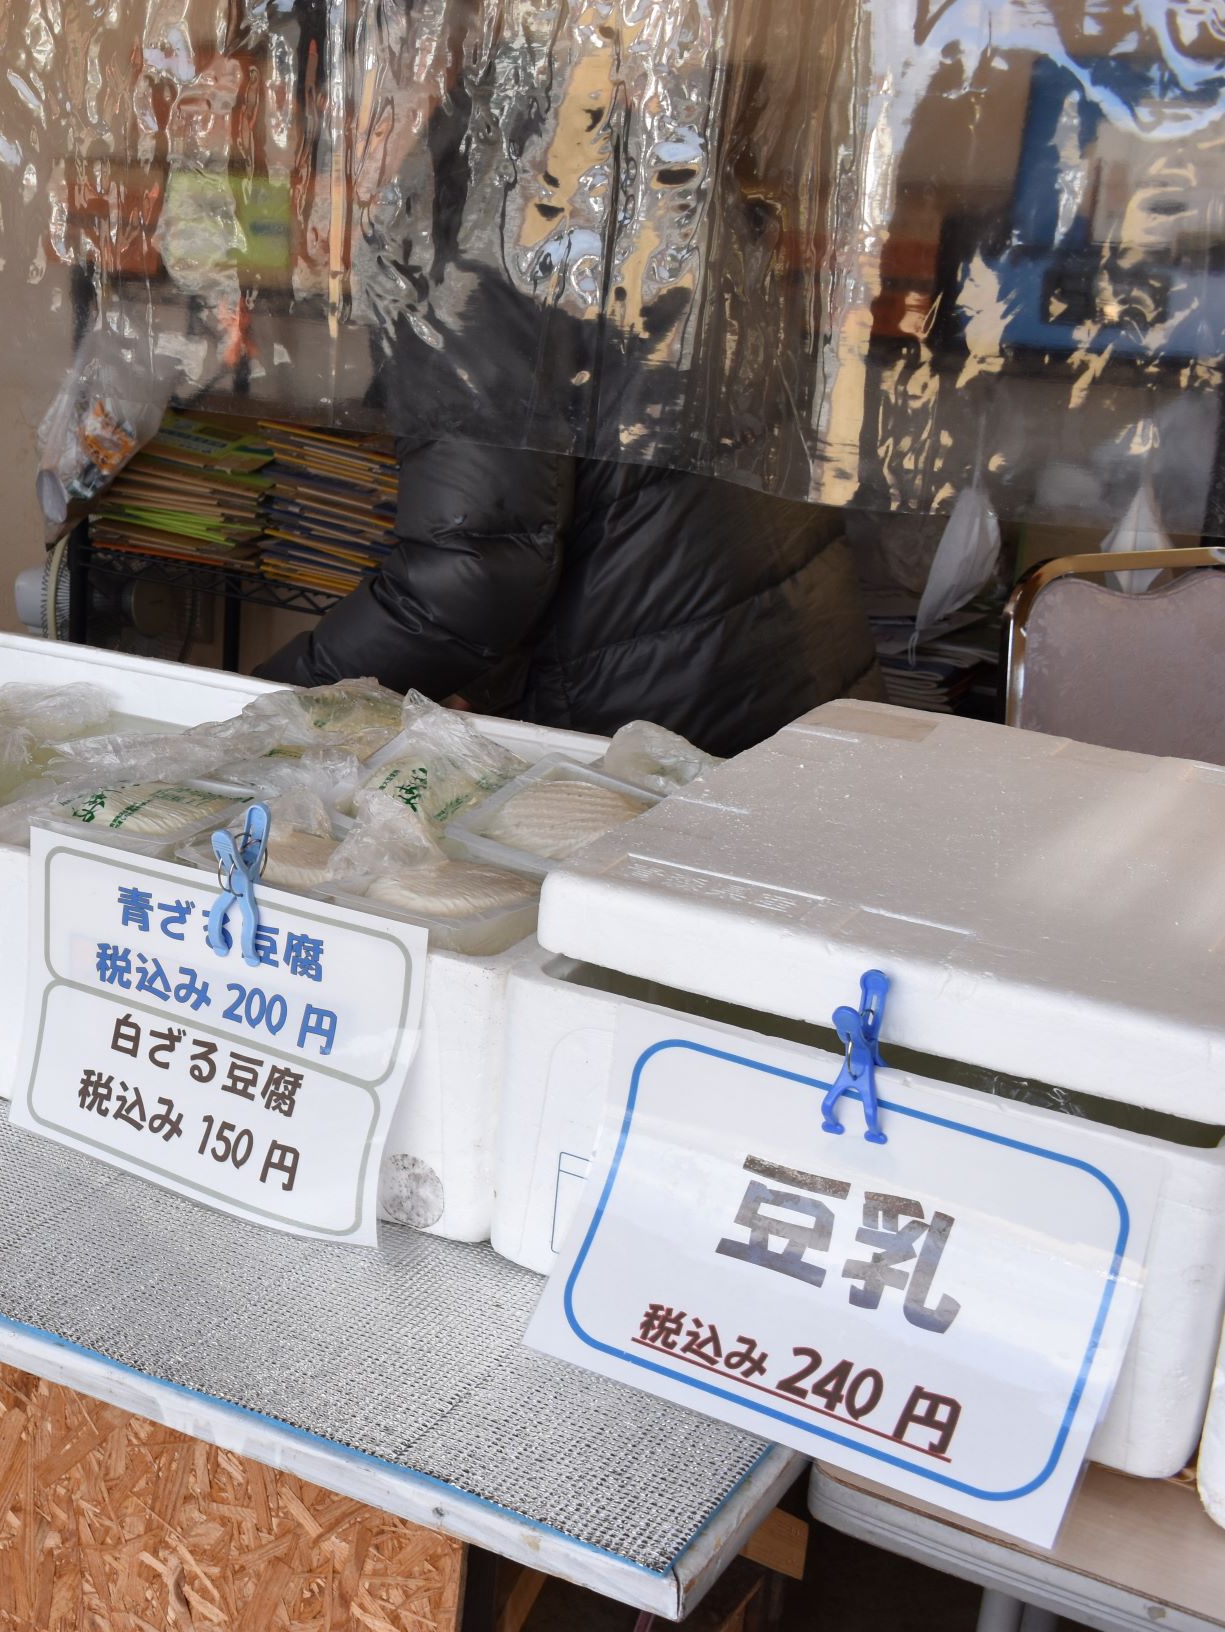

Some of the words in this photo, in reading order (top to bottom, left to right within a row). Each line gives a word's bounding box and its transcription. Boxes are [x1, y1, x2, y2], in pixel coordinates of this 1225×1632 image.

[111, 1014, 304, 1117] 白ざる豆腐
[715, 1155, 961, 1334] 豆乳
